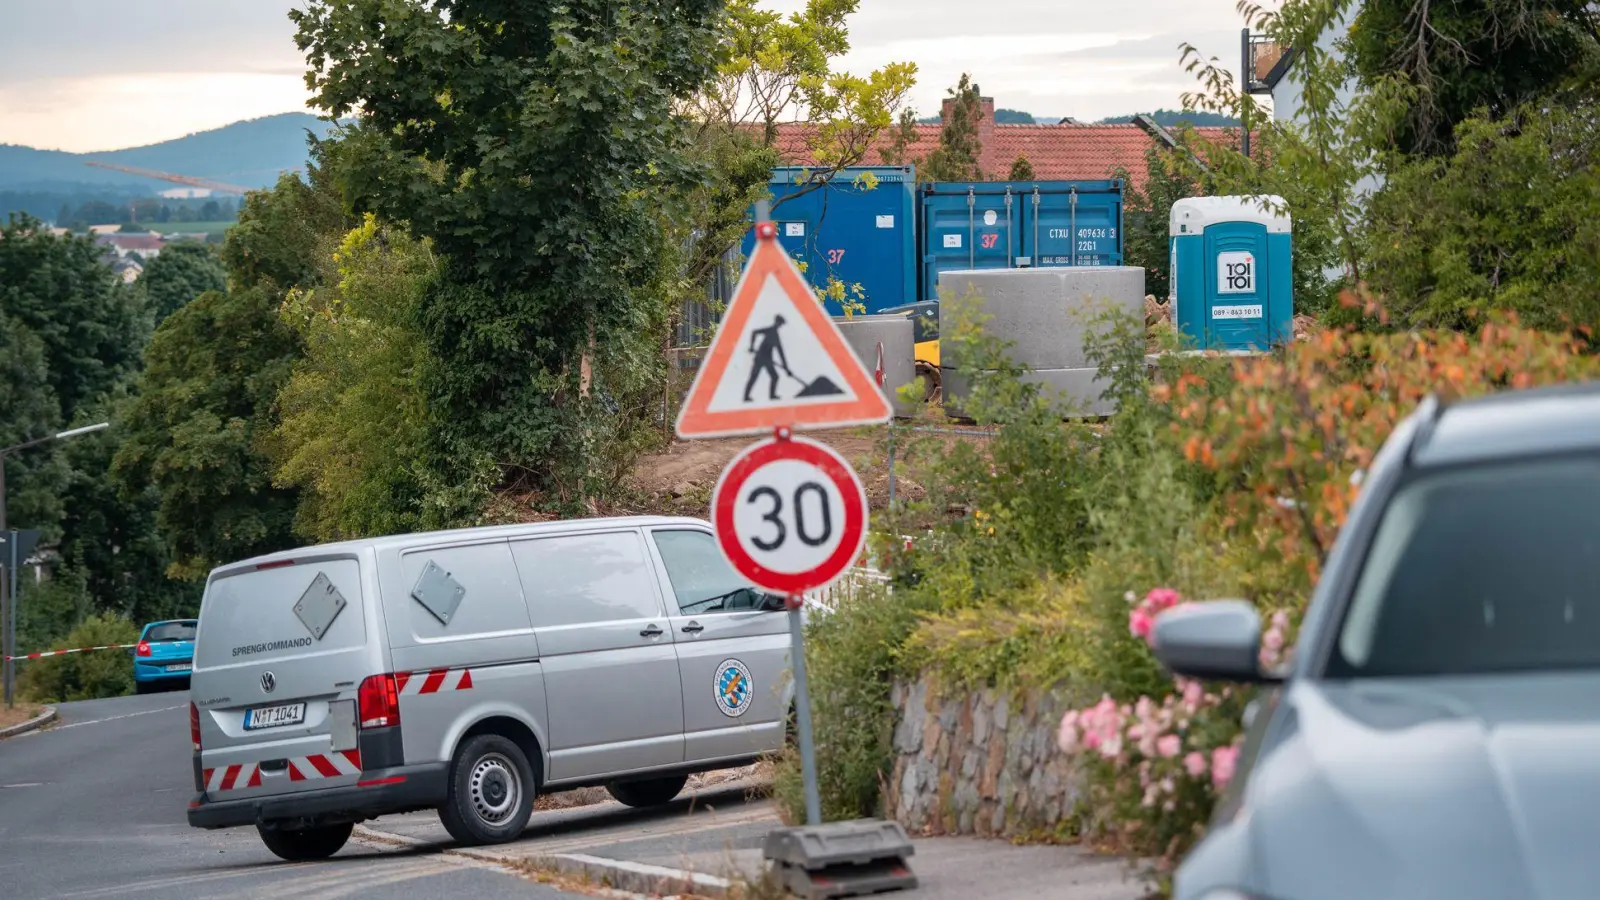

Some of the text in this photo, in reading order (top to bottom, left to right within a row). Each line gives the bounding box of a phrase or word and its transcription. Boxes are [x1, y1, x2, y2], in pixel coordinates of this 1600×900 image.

[981, 233, 998, 248] 37
[1049, 228, 1116, 239] CTXU 409636 3
[1078, 241, 1097, 251] 22G1
[828, 249, 845, 264] 37
[1226, 261, 1251, 276] TOI
[1226, 276, 1251, 289] TOI
[747, 481, 832, 551] 30
[232, 637, 312, 657] SPRENGKOMMANDO
